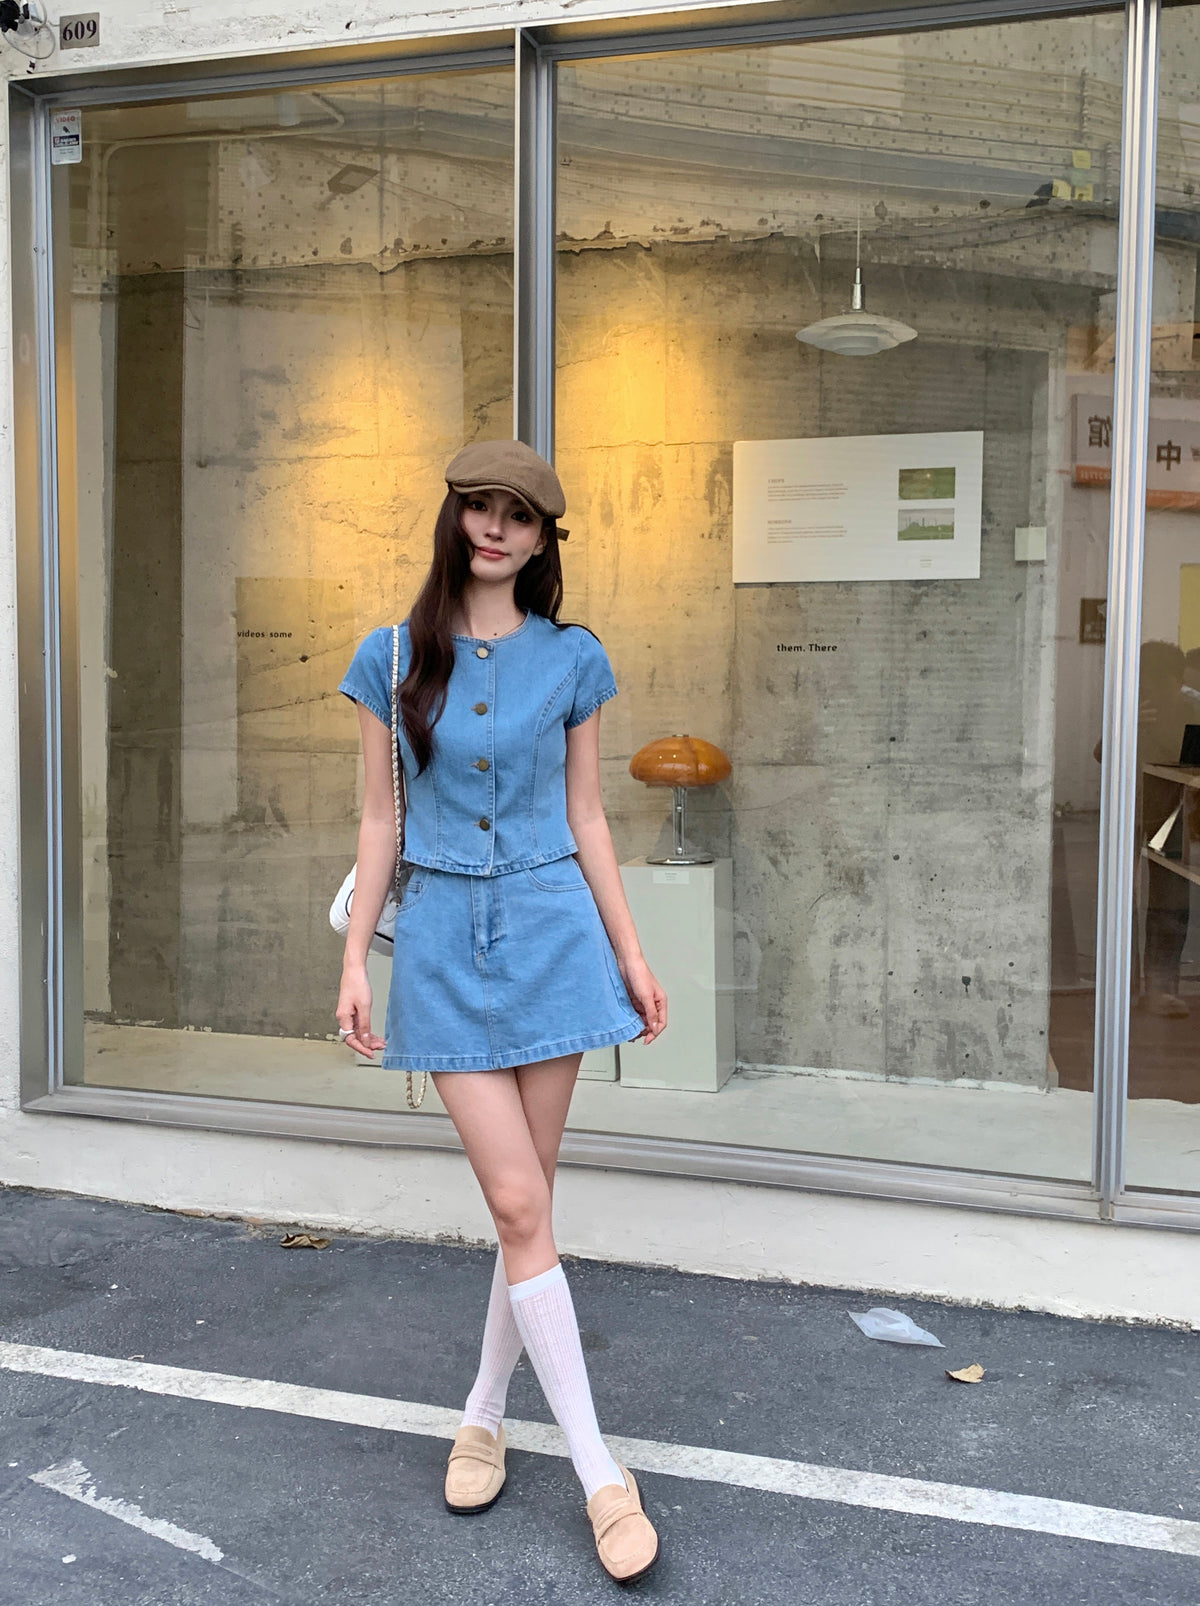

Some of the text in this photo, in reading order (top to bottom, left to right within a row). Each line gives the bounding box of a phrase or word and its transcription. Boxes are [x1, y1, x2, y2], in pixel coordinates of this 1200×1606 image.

[62, 19, 97, 42] 609
[236, 629, 266, 638] videos
[776, 643, 838, 652] them. There
